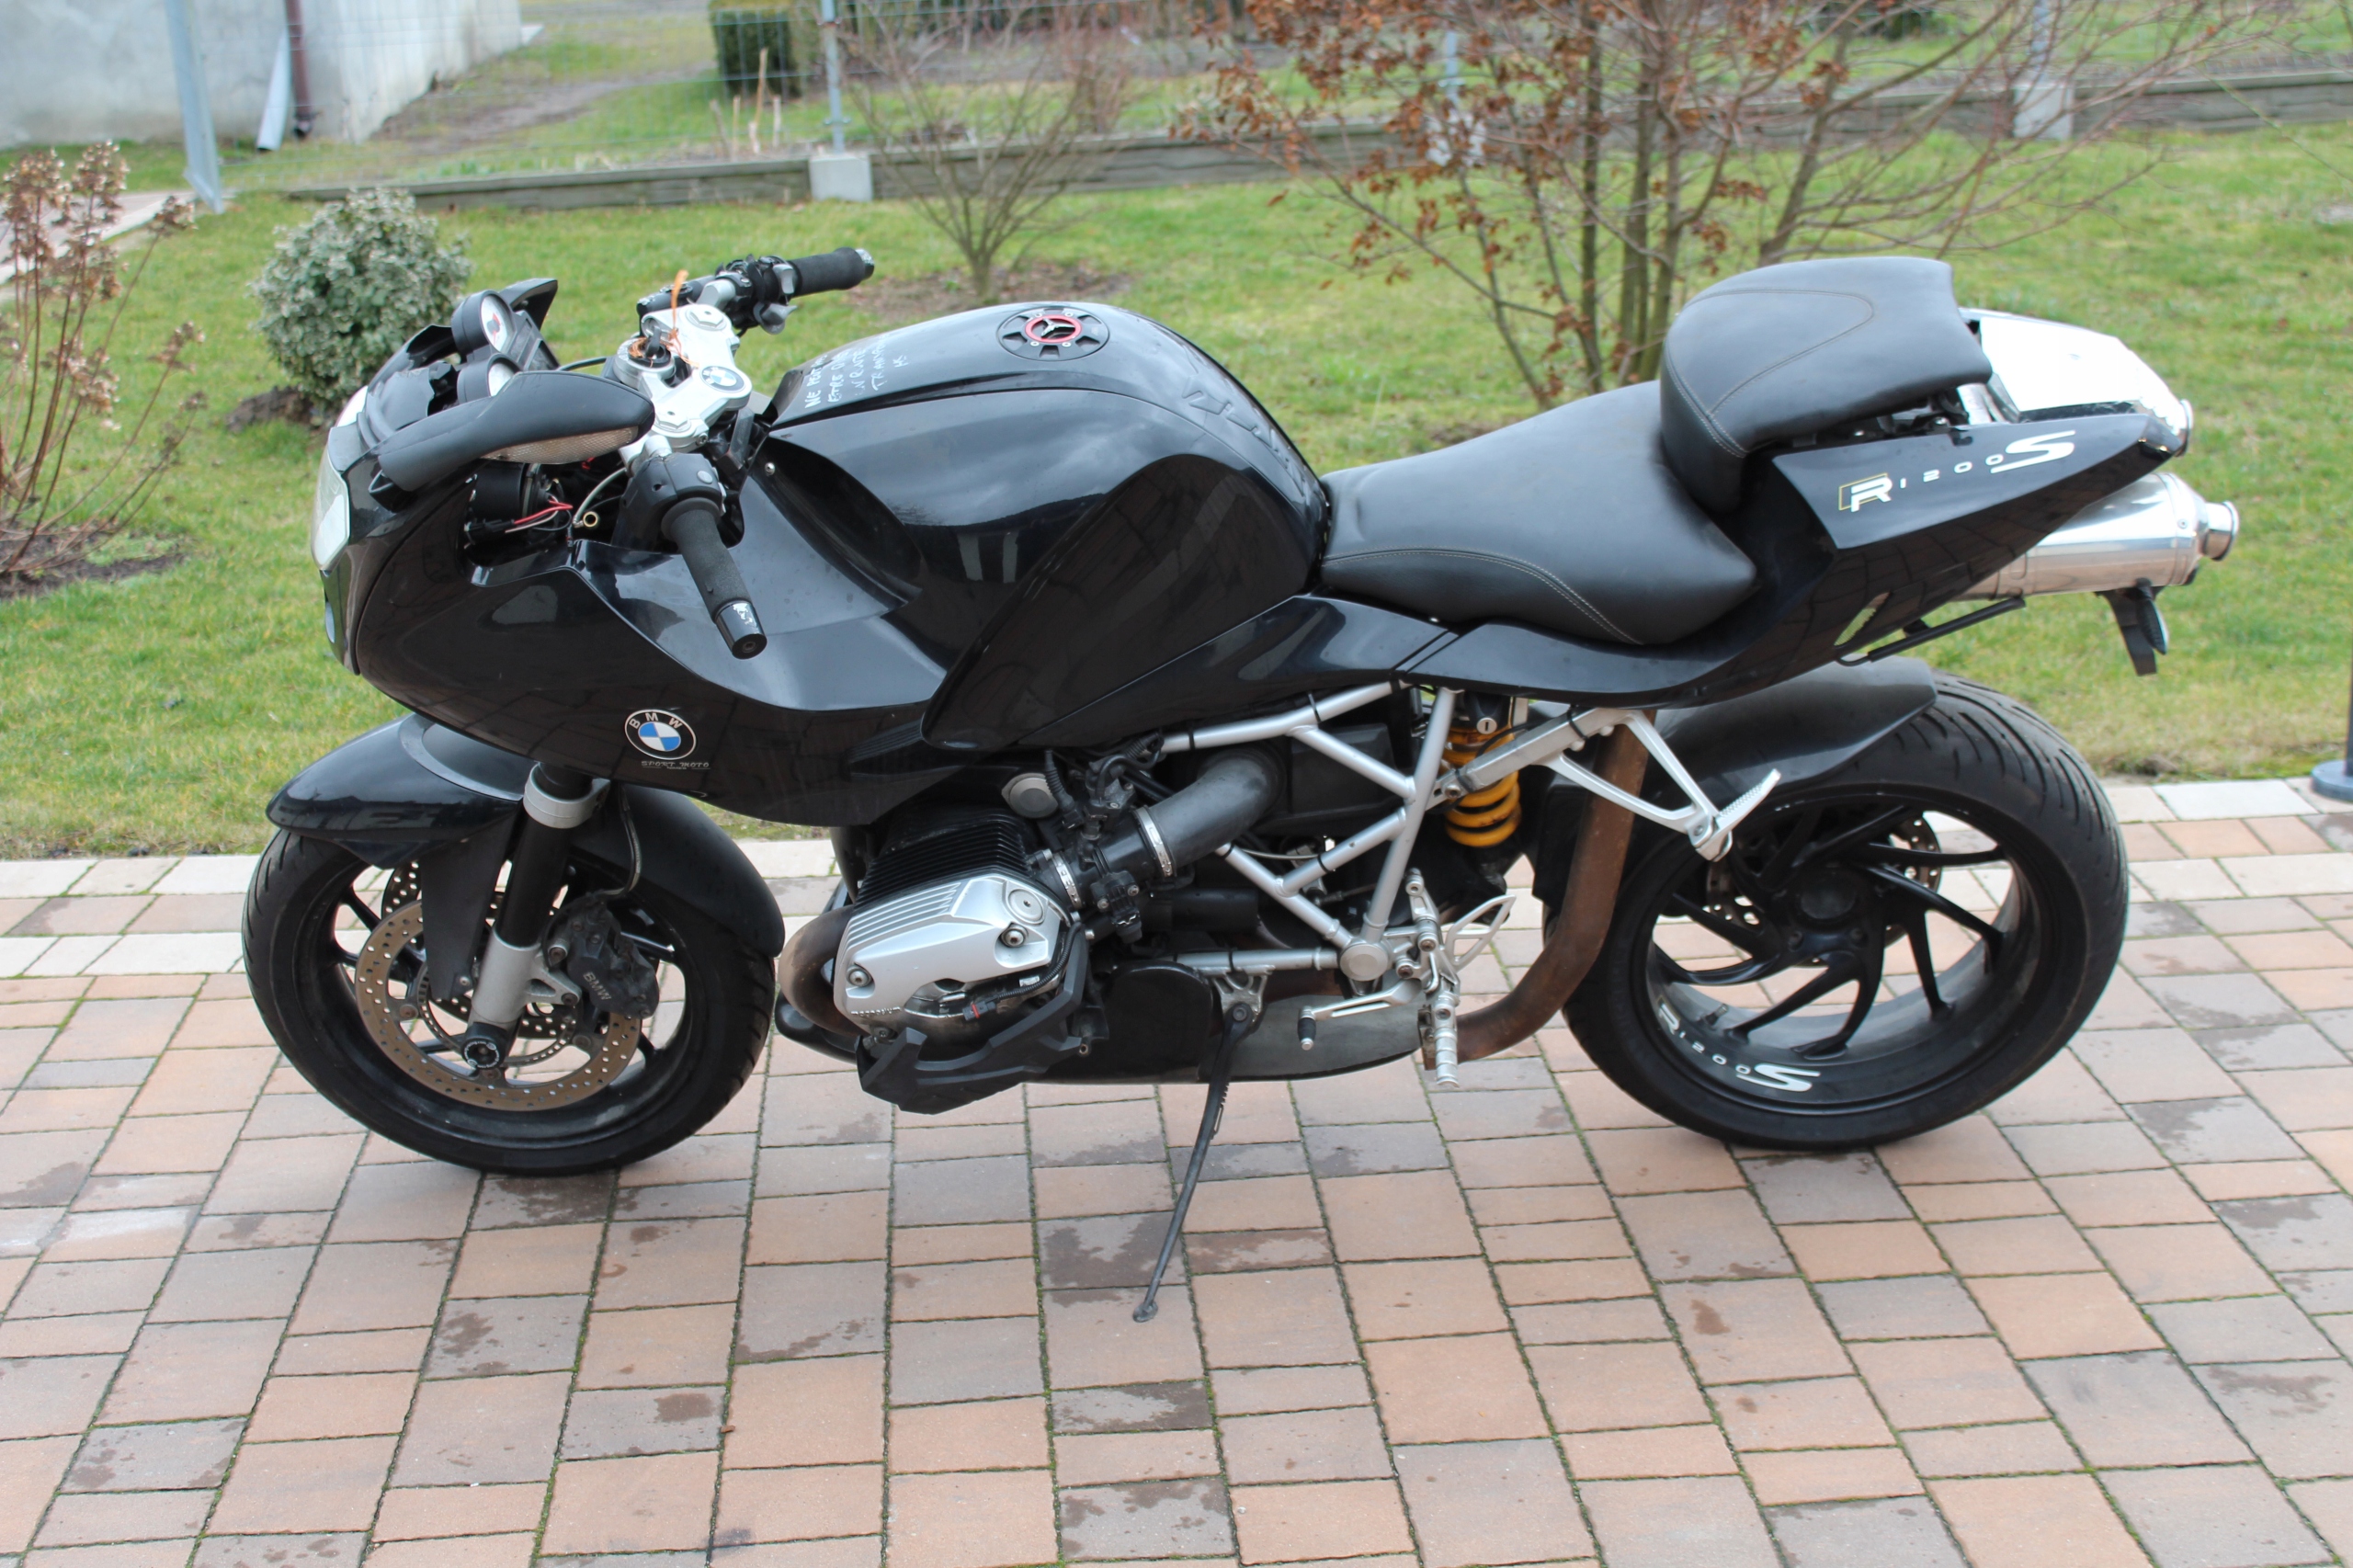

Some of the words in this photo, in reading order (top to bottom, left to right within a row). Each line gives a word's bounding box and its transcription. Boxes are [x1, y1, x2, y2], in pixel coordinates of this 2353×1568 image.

[804, 390, 822, 409] NE
[641, 760, 676, 768] SPORT
[582, 971, 612, 1001] BMW
